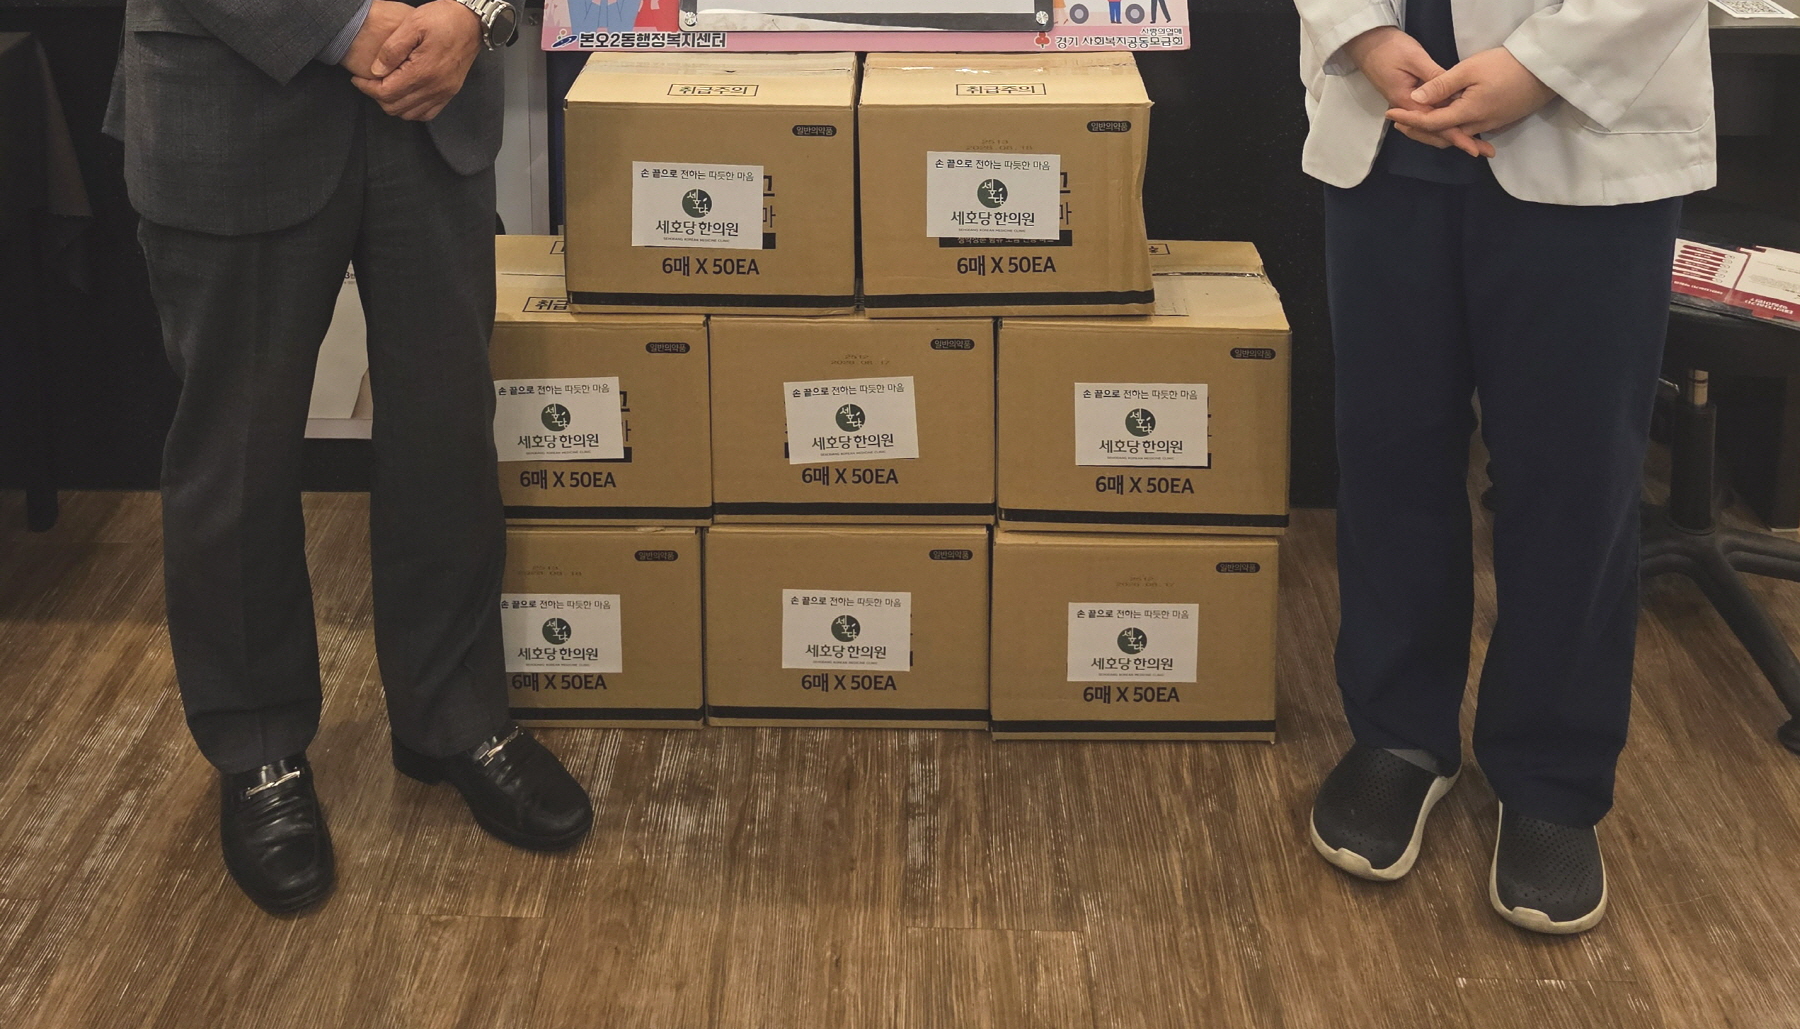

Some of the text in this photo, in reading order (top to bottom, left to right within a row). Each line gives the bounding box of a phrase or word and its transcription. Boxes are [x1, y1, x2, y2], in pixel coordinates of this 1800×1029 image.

[580, 32, 726, 48] 본오2동행정복지센터
[1055, 36, 1183, 48] 경기 사회복지공동모금회
[679, 85, 748, 96] 취급주의
[966, 84, 1035, 95] 취급주의
[796, 125, 833, 136] 일반의약품
[1090, 121, 1128, 132] 일반의약품
[935, 159, 944, 168] 손
[946, 159, 973, 168] 끝으로
[975, 160, 1001, 170] 전하는
[1033, 161, 1050, 170] 마음
[641, 168, 649, 178] 손
[652, 169, 678, 178] 끝으로
[680, 170, 706, 180] 전하는
[737, 171, 754, 182] 마음
[662, 256, 760, 276] 6매 X 50EA
[956, 255, 1056, 276] 6매 X 50EA
[535, 299, 568, 311] 취급
[934, 339, 971, 349] 일반의약품
[1234, 349, 1271, 359] 일반의약품
[498, 387, 507, 395] 손
[509, 385, 535, 395] 끝으로
[537, 385, 562, 395] 전하는
[592, 383, 610, 393] 마음
[792, 388, 801, 398] 손
[803, 387, 829, 397] 끝으로
[831, 385, 857, 395] 전하는
[887, 382, 905, 393] 마음
[1083, 389, 1091, 398] 손
[1094, 390, 1120, 398] 끝으로
[1123, 390, 1149, 399] 전하는
[1180, 390, 1198, 400] 마음
[520, 469, 616, 490] 6매 X 50EA
[801, 466, 899, 486] 6매 X 50EA
[1095, 474, 1194, 495] 6매 X 50EA
[501, 600, 611, 609] 손 끝으로 전하는 마음
[790, 596, 902, 607] 손 끝으로 전하는 마음
[1076, 609, 1189, 619] 손 끝으로 전하는 마음
[511, 673, 607, 691] 6매 50EA
[801, 673, 897, 692] 6매 50EA
[1083, 685, 1179, 704] 6매 50EA
